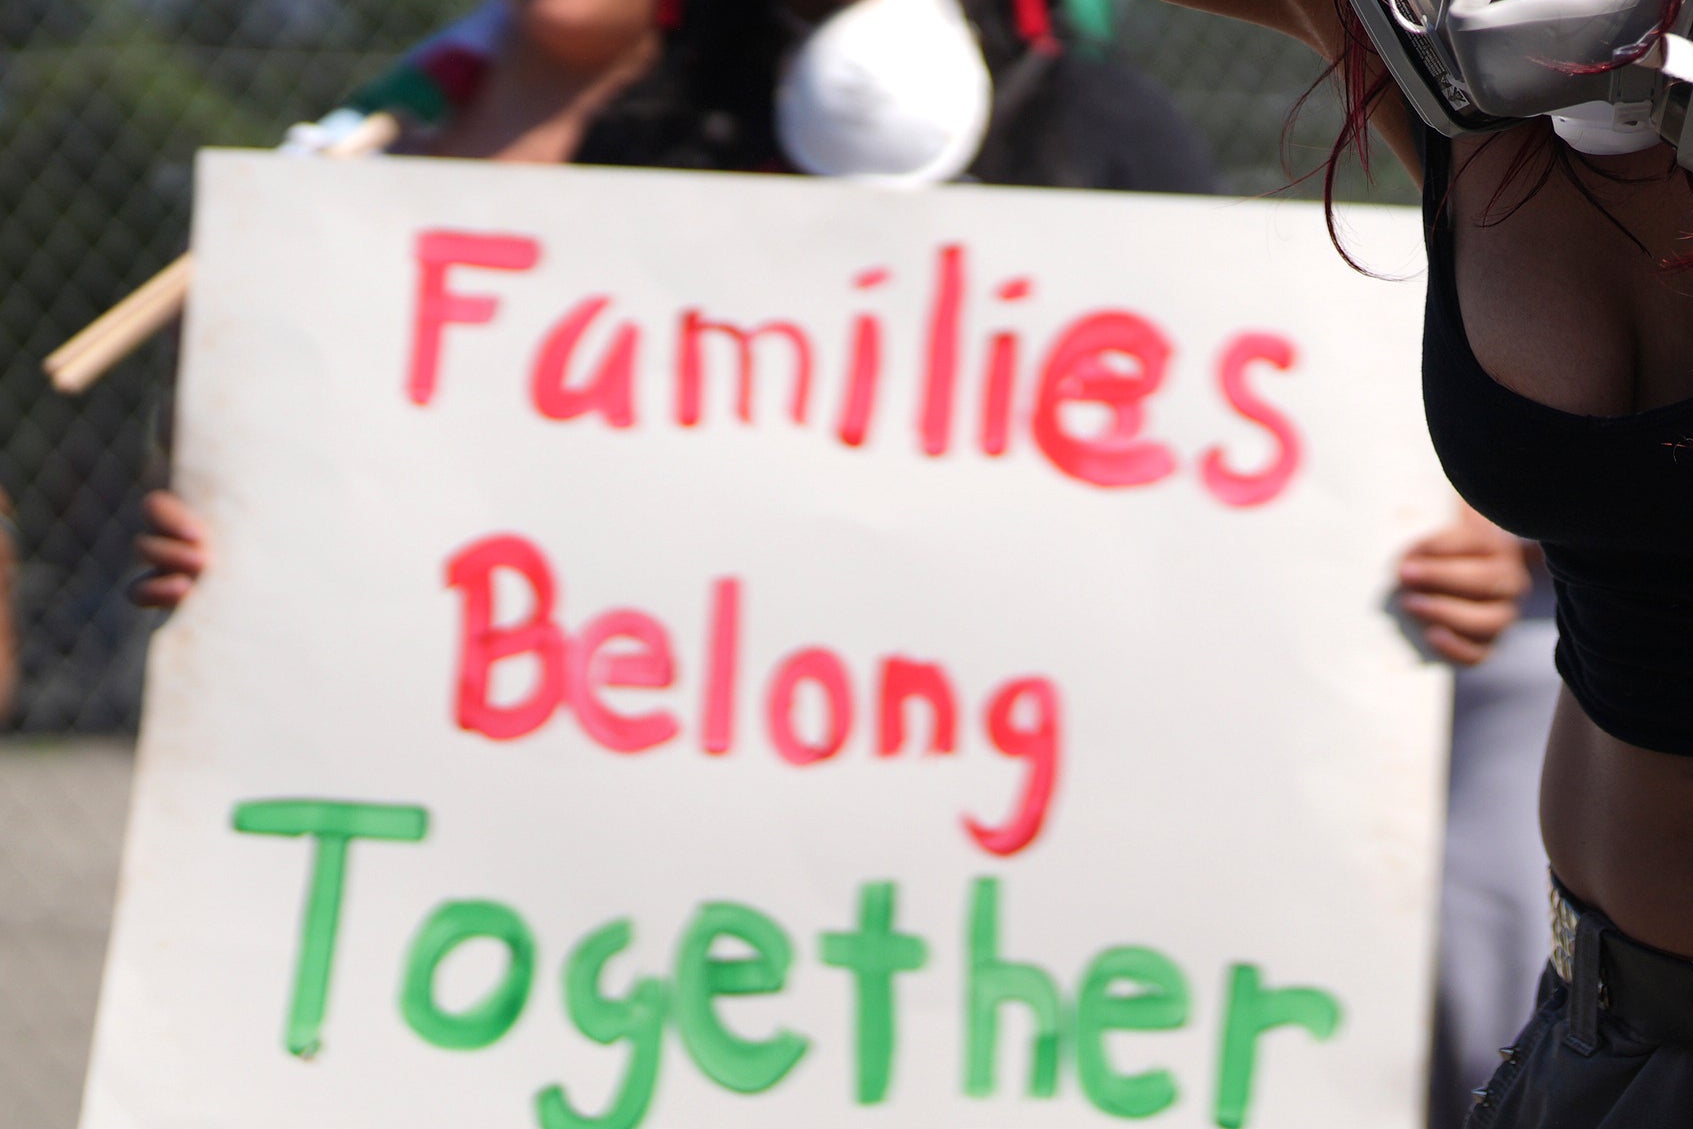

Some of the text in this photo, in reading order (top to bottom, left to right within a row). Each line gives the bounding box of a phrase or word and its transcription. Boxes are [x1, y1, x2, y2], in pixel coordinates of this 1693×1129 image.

[403, 227, 1304, 509] Families
[443, 531, 1064, 860] Belong
[231, 797, 1342, 1129] Together
